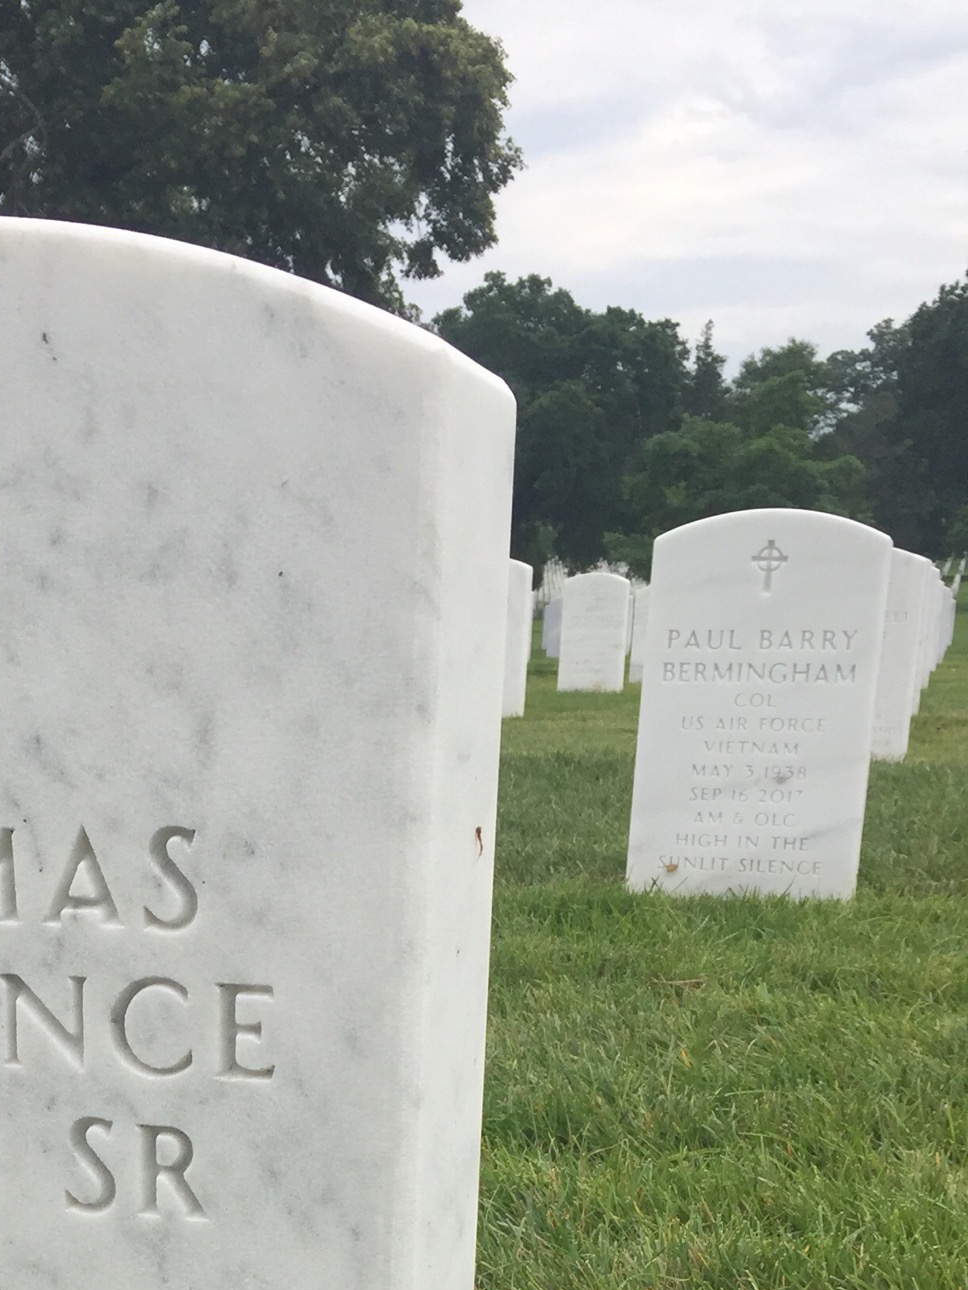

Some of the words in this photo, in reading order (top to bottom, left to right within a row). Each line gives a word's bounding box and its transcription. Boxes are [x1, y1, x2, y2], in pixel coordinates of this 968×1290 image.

[667, 629, 742, 650] PAUL
[759, 629, 858, 650] BARRY
[662, 662, 857, 684] BERMINGHAM
[734, 692, 776, 708] COL
[682, 716, 704, 731] US
[716, 716, 748, 731] AIR
[759, 717, 827, 733] FORCE
[704, 740, 799, 755] VIETNAM
[691, 764, 733, 777] MAY
[745, 765, 754, 778] 3
[764, 765, 807, 780] 1938
[689, 786, 722, 801] SEP
[732, 788, 749, 802] 16
[759, 789, 803, 803] 2017
[694, 811, 723, 824] AM
[733, 812, 744, 825] &
[754, 812, 797, 827] OLC
[675, 833, 728, 848] HIGH
[737, 835, 759, 848] IN
[771, 836, 810, 851] THE
[737, 858, 823, 875] SILENCE
[64, 1116, 209, 1222] SR
